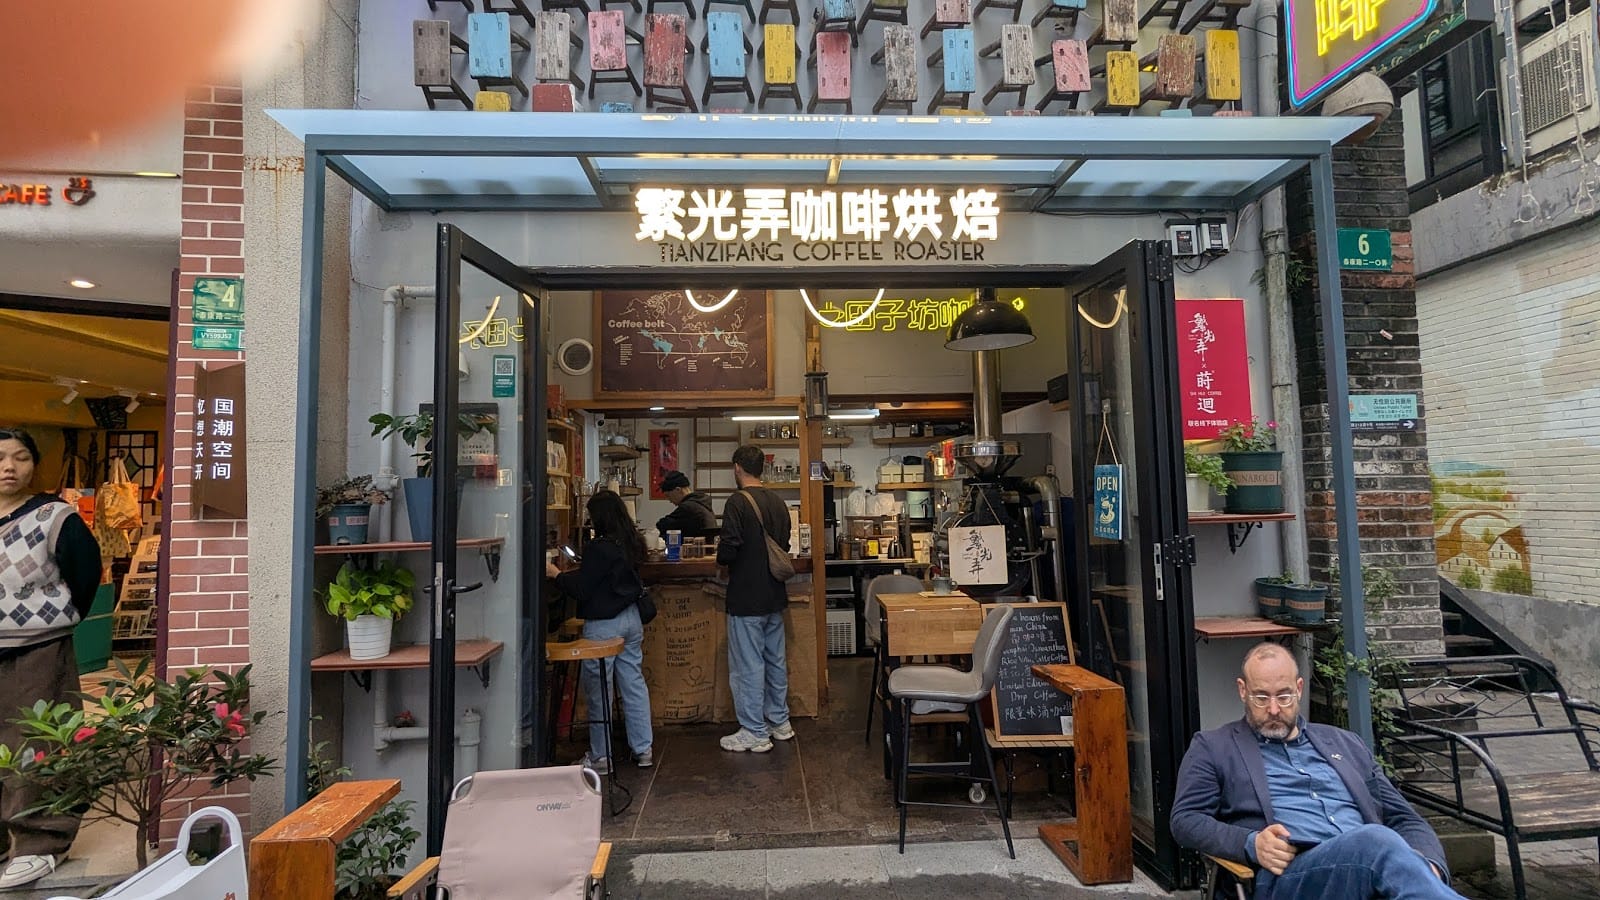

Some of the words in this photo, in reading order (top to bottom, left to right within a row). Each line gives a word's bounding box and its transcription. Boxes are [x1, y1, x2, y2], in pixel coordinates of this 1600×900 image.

[634, 187, 1001, 241] 繁光弄咖啡烘焙
[658, 241, 784, 262] TIANZIFANG
[793, 240, 884, 262] COFFEE
[894, 240, 985, 262] ROASTER
[1358, 233, 1370, 255] 6
[221, 284, 235, 308] 4
[607, 319, 643, 329] Coffee
[644, 319, 666, 329] belt
[212, 398, 233, 479] 国潮空间
[1096, 476, 1118, 491] OPEN
